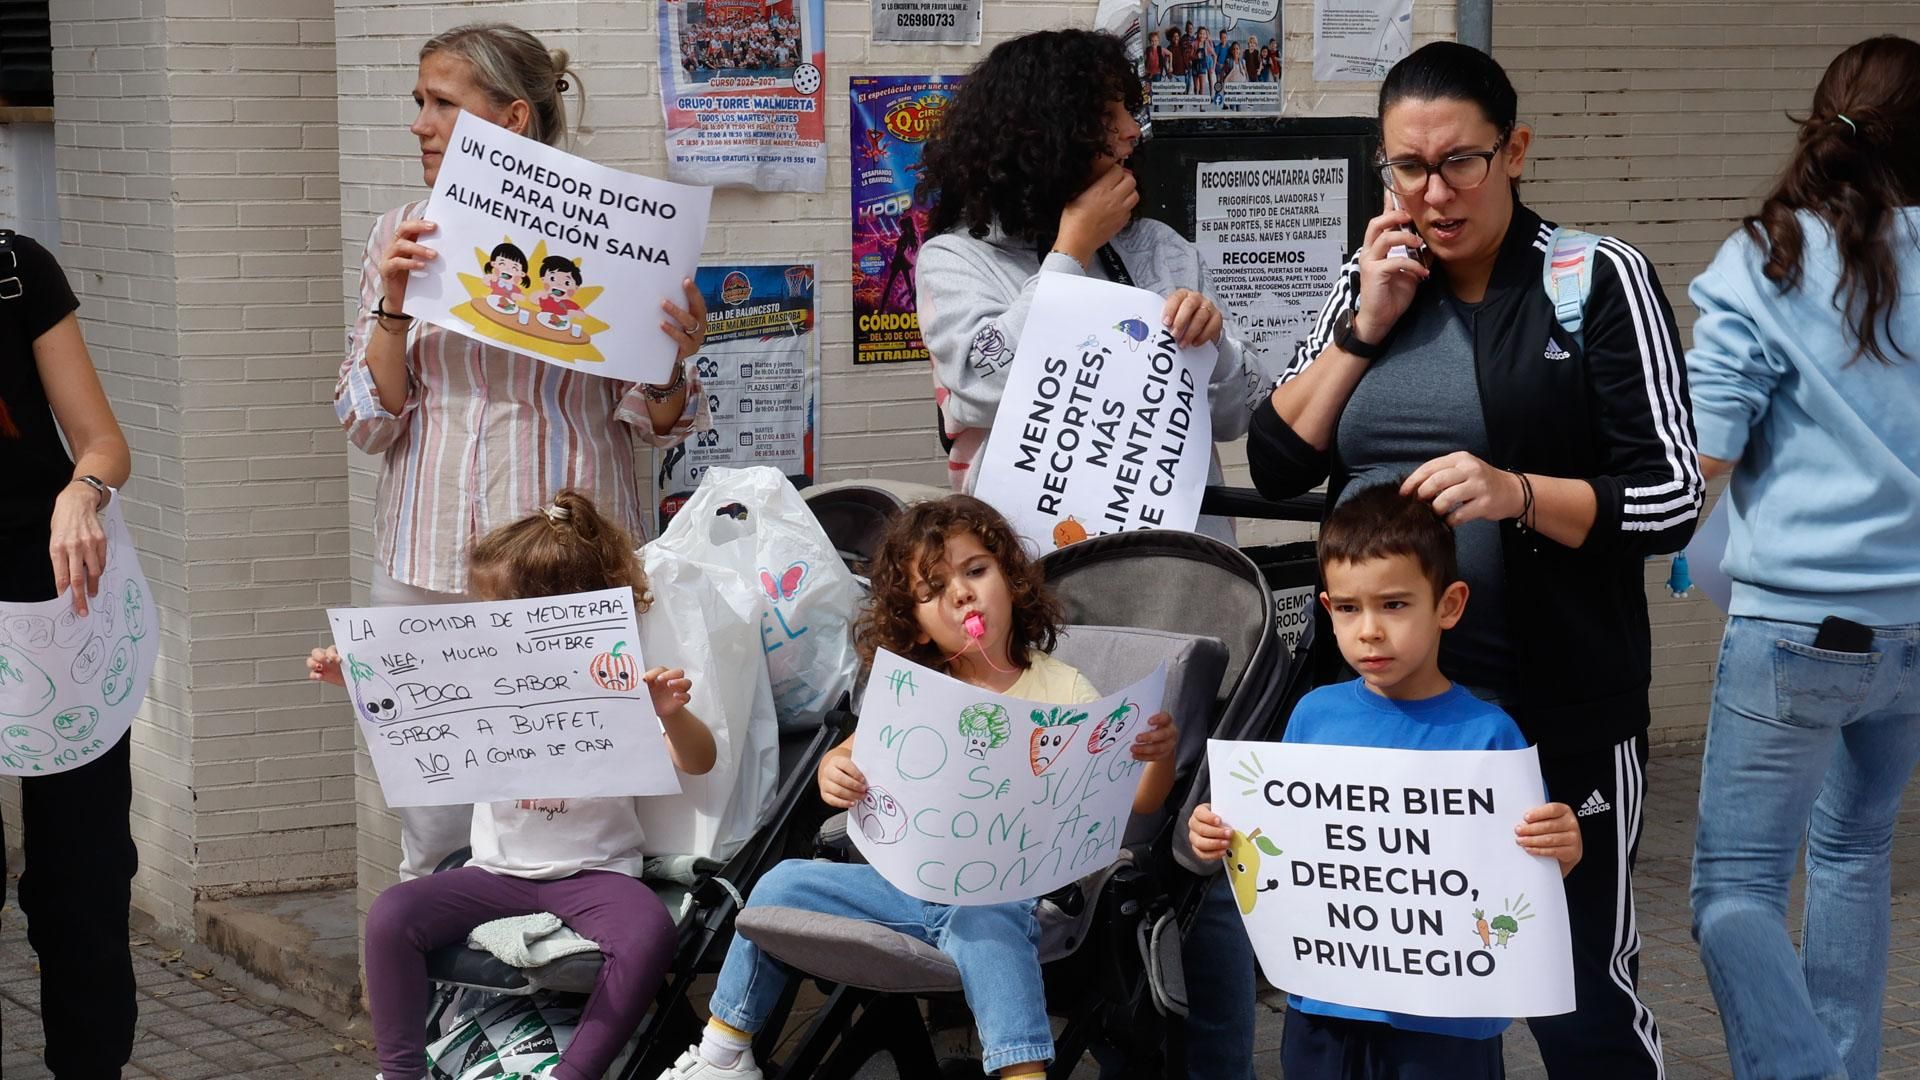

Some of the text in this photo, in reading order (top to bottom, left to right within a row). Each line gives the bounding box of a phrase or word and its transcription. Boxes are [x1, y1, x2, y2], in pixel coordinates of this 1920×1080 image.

[1225, 3, 1273, 16] material escolar
[897, 13, 955, 27] 626980733
[710, 78, 734, 87] CURSO
[858, 93, 867, 103] El
[868, 83, 911, 99] espectáculo
[912, 84, 927, 92] que
[678, 97, 815, 111] GRUPO TORRE MALMUERTA
[697, 114, 797, 122] TODOS LOS MARTES JUEVES
[896, 110, 940, 132] QUI
[918, 109, 944, 119] CIRC
[461, 136, 677, 220] UN COMEDOR DIGNO
[861, 179, 869, 187] LA
[1201, 168, 1344, 189] RECOGEMOS CHATARRA GRATIS
[500, 179, 610, 229] PARA UNA
[859, 193, 912, 220] KPOP
[1218, 192, 1325, 206] FRIGORÍFICOS, LAVADORAS Y
[1226, 205, 1319, 218] TODO TIPO DE CHATARRA
[445, 184, 671, 266] ALIMENTACIÓN SANA
[1201, 217, 1342, 232] SE DAN PORTES, SE HACEN LIMPIEZAS
[1218, 232, 1229, 243] DE
[1259, 231, 1284, 242] NAVES
[1285, 231, 1291, 241] Y
[1292, 230, 1327, 240] GARAJES
[1222, 251, 1305, 265] RECOGEMOS
[1209, 266, 1267, 276] CTRODOMÉSTICOS,
[1268, 266, 1293, 274] PUERTAS
[1248, 275, 1285, 283] LAVADORAS,
[1285, 274, 1304, 282] PAPEL
[1254, 283, 1290, 291] RECOGEMOS
[1291, 282, 1312, 290] ACEITE
[1312, 282, 1333, 290] USADO
[1272, 291, 1291, 299] EMOS
[1291, 290, 1323, 298] LIMPIEZAS
[725, 309, 735, 319] DE
[735, 302, 780, 317] BALONCESTO
[1228, 300, 1248, 308] NAVES,
[726, 315, 766, 330] MALMUERTA
[859, 309, 920, 332] CÓRDOB
[870, 331, 922, 341] DEL 30 DE OCTU
[858, 348, 929, 362] ENTRADAS
[1544, 351, 1570, 360] adidas
[747, 383, 769, 391] PLAZAS
[1014, 357, 1067, 473] MENOS
[1036, 347, 1112, 516] RECORTES,
[1086, 399, 1125, 468] MÁS
[1137, 367, 1195, 530] E CALIDAD
[399, 614, 476, 635] COMIDA
[490, 612, 513, 628] DE
[381, 636, 595, 668] NEA, MUCHO NOMBRE
[396, 682, 472, 704] POCO
[477, 718, 494, 736] A
[511, 710, 604, 735] BUFFET,
[415, 737, 615, 774] NO A COMIDA DE CASA
[879, 724, 948, 781] NO
[1263, 779, 1495, 815] COMER BIEN
[1577, 801, 1611, 817] adidas
[913, 806, 1025, 846] CON
[1325, 823, 1431, 855] ES UN
[1291, 860, 1480, 902] DERECHO,
[1327, 902, 1444, 936] NO UN
[1293, 936, 1496, 977] PRIVILEGIO
